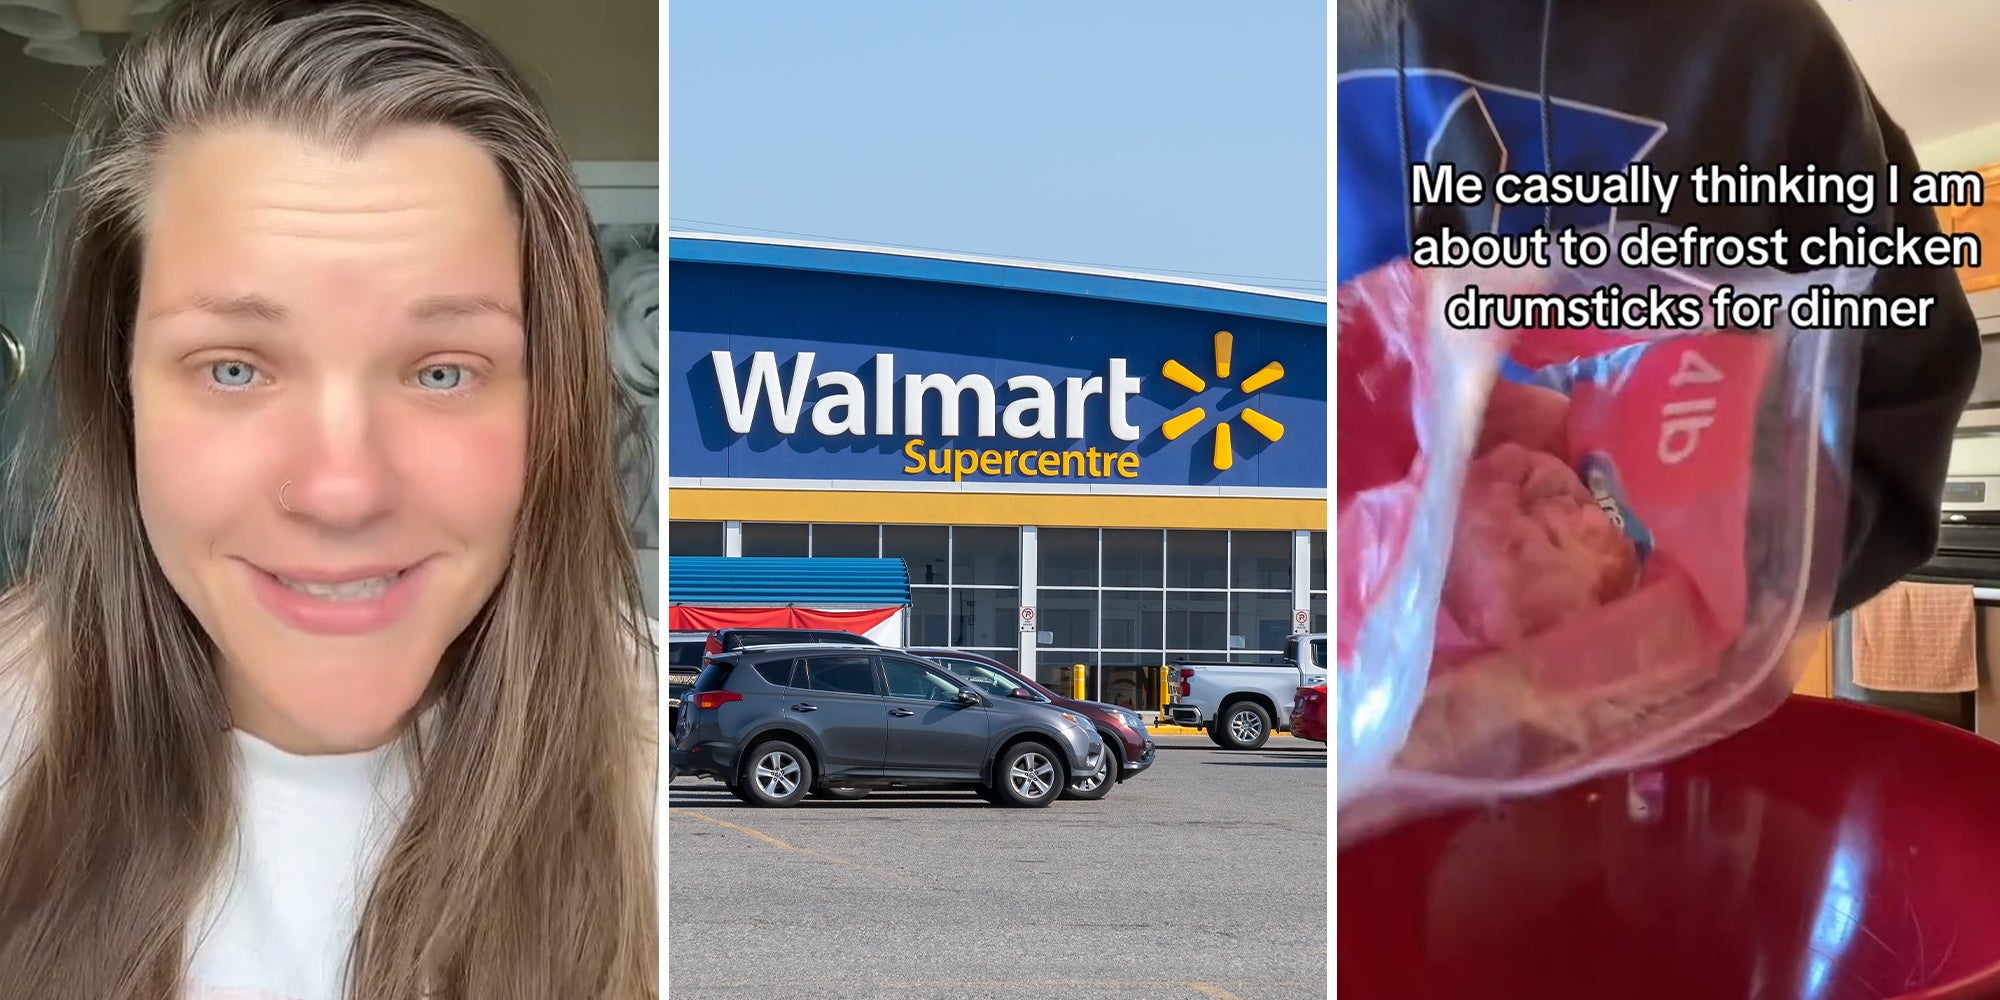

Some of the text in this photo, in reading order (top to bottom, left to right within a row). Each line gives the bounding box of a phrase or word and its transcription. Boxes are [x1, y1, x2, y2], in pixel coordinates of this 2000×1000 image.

[711, 350, 1141, 441] Walmart
[1658, 350, 1724, 464] 4 lb
[904, 438, 1140, 483] Supercentre
